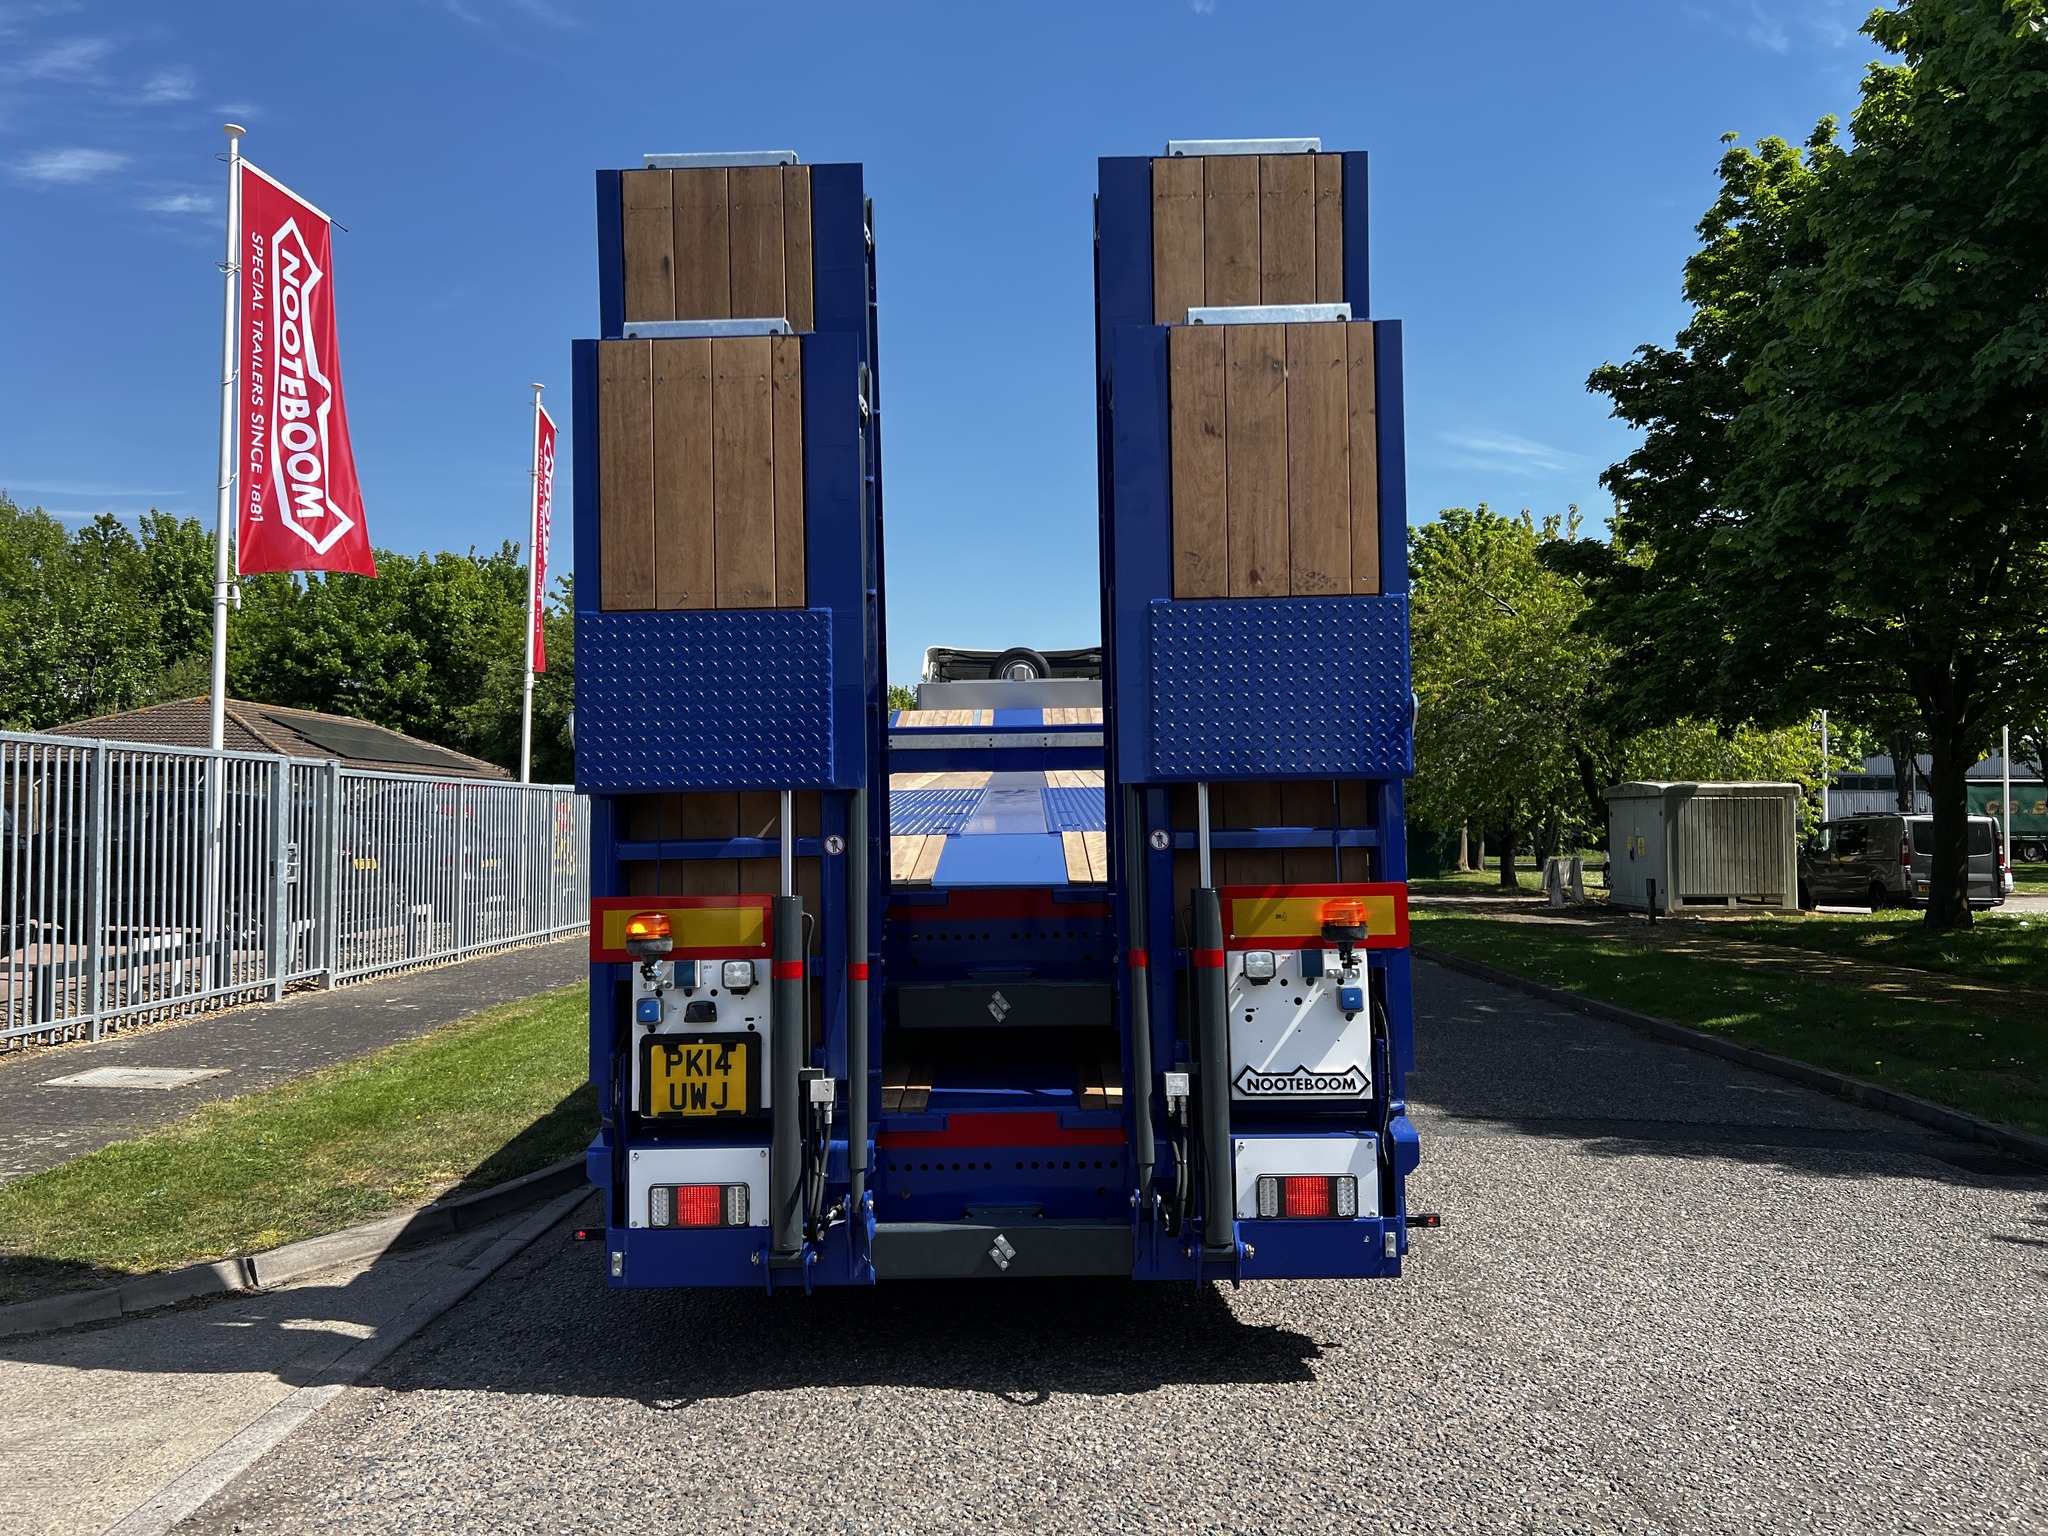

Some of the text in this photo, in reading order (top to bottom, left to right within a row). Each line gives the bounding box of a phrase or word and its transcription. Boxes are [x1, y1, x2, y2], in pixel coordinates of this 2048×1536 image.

[249, 232, 265, 523] SPECIAL TRAILERS SINCE 1881
[280, 248, 325, 518] NOOTEBOOM
[665, 1049, 732, 1077] PK14
[669, 1081, 728, 1110] UWJ
[1247, 1077, 1357, 1092] NOOTEBOOM
